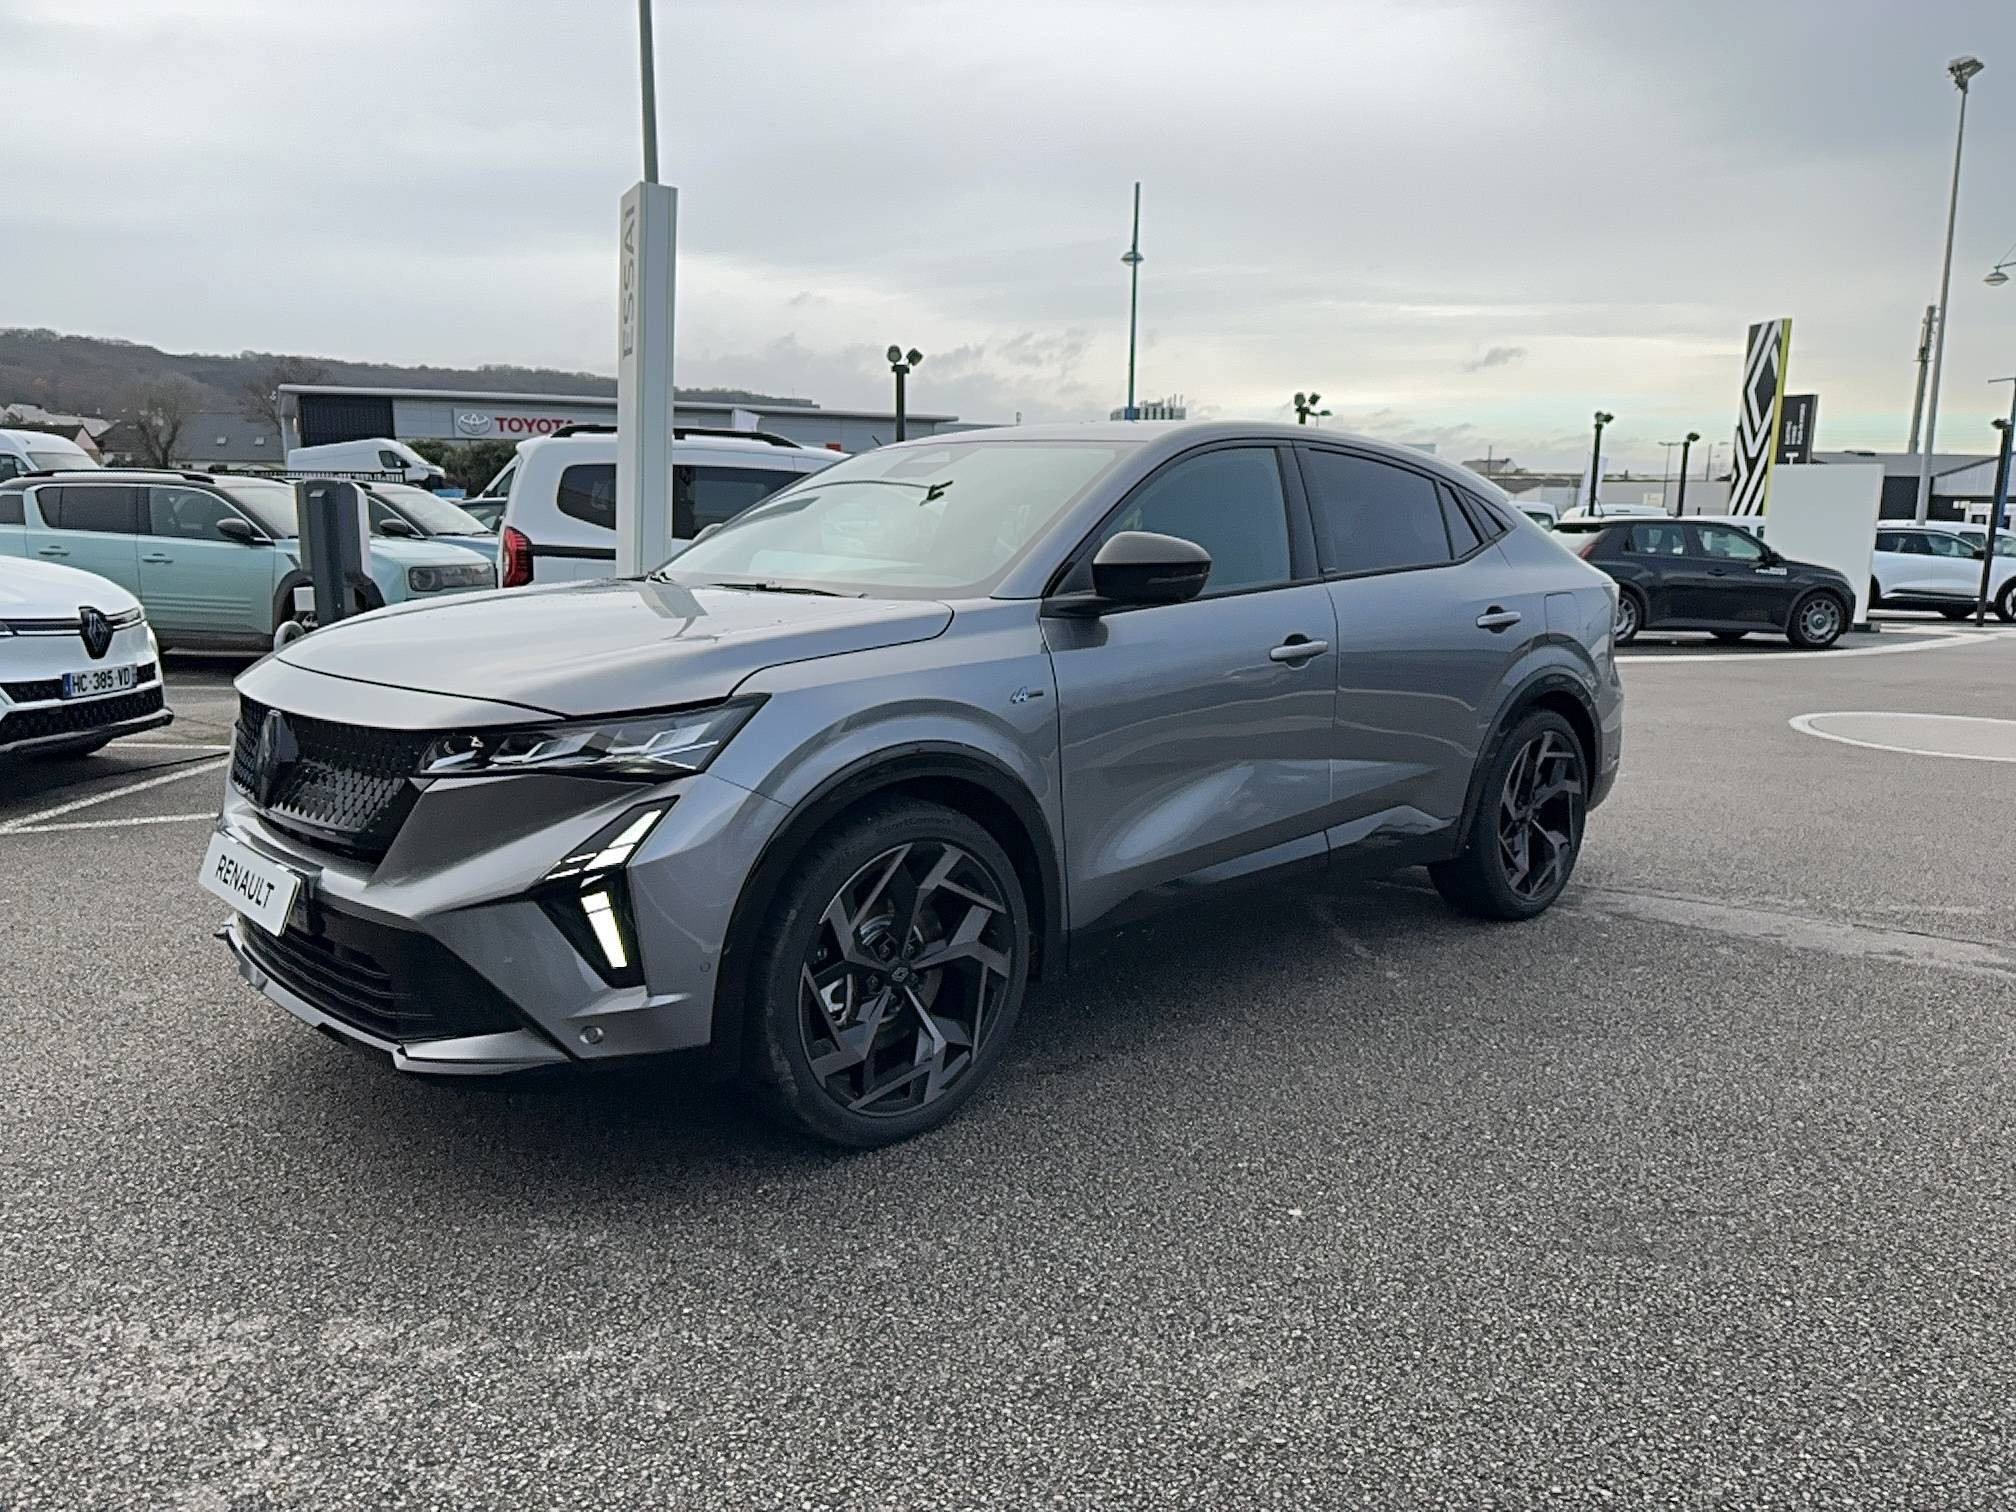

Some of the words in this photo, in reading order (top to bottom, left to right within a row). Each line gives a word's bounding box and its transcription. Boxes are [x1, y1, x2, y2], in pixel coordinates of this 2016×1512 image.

[623, 205, 635, 360] ESSAI
[494, 416, 574, 433] TOYOT
[215, 854, 275, 908] RENAULT
